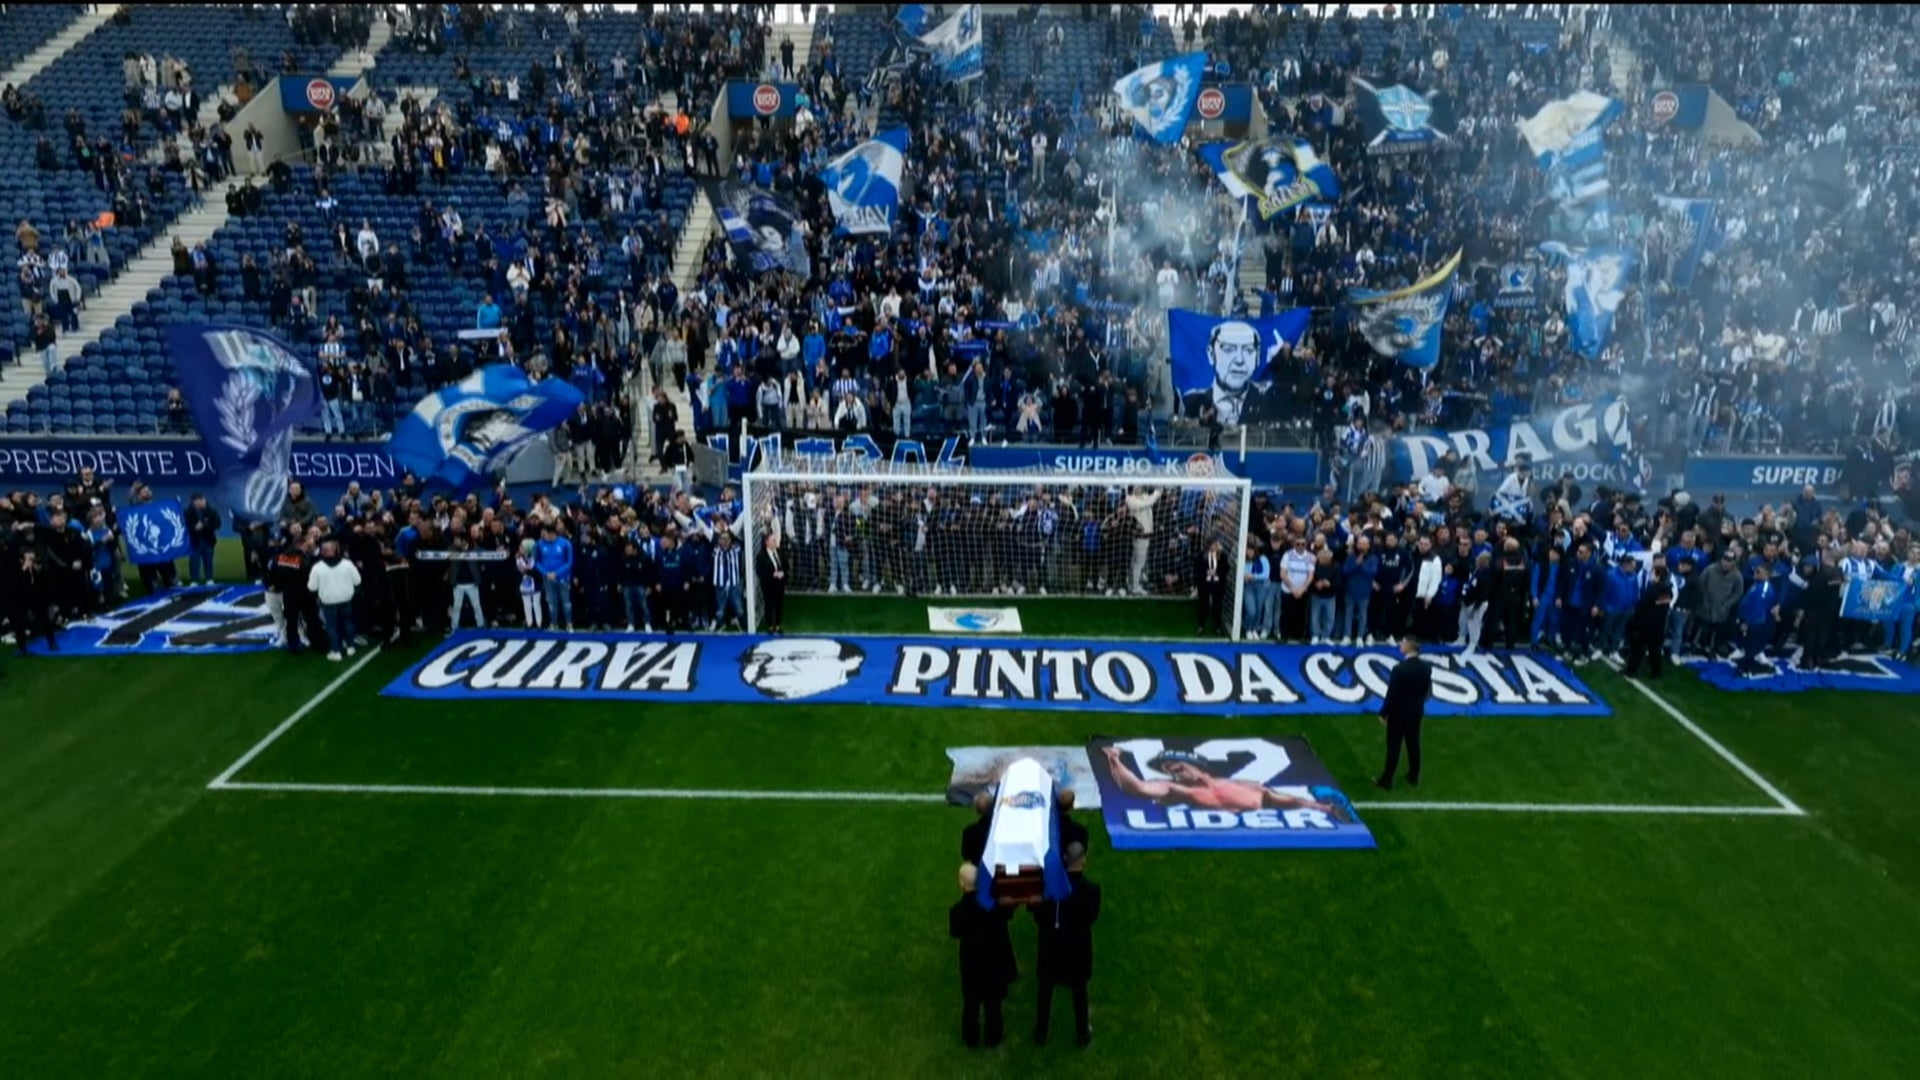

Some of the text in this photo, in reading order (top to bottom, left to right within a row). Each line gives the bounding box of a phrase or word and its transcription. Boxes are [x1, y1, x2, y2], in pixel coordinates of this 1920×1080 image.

[287, 452, 395, 477] ESIDEN
[1054, 454, 1118, 473] SUPER
[1122, 456, 1180, 475] BOK
[1752, 465, 1819, 485] SUPER
[415, 638, 699, 691] CURVA
[892, 646, 1152, 702] PINTO
[1171, 652, 1301, 702] DA
